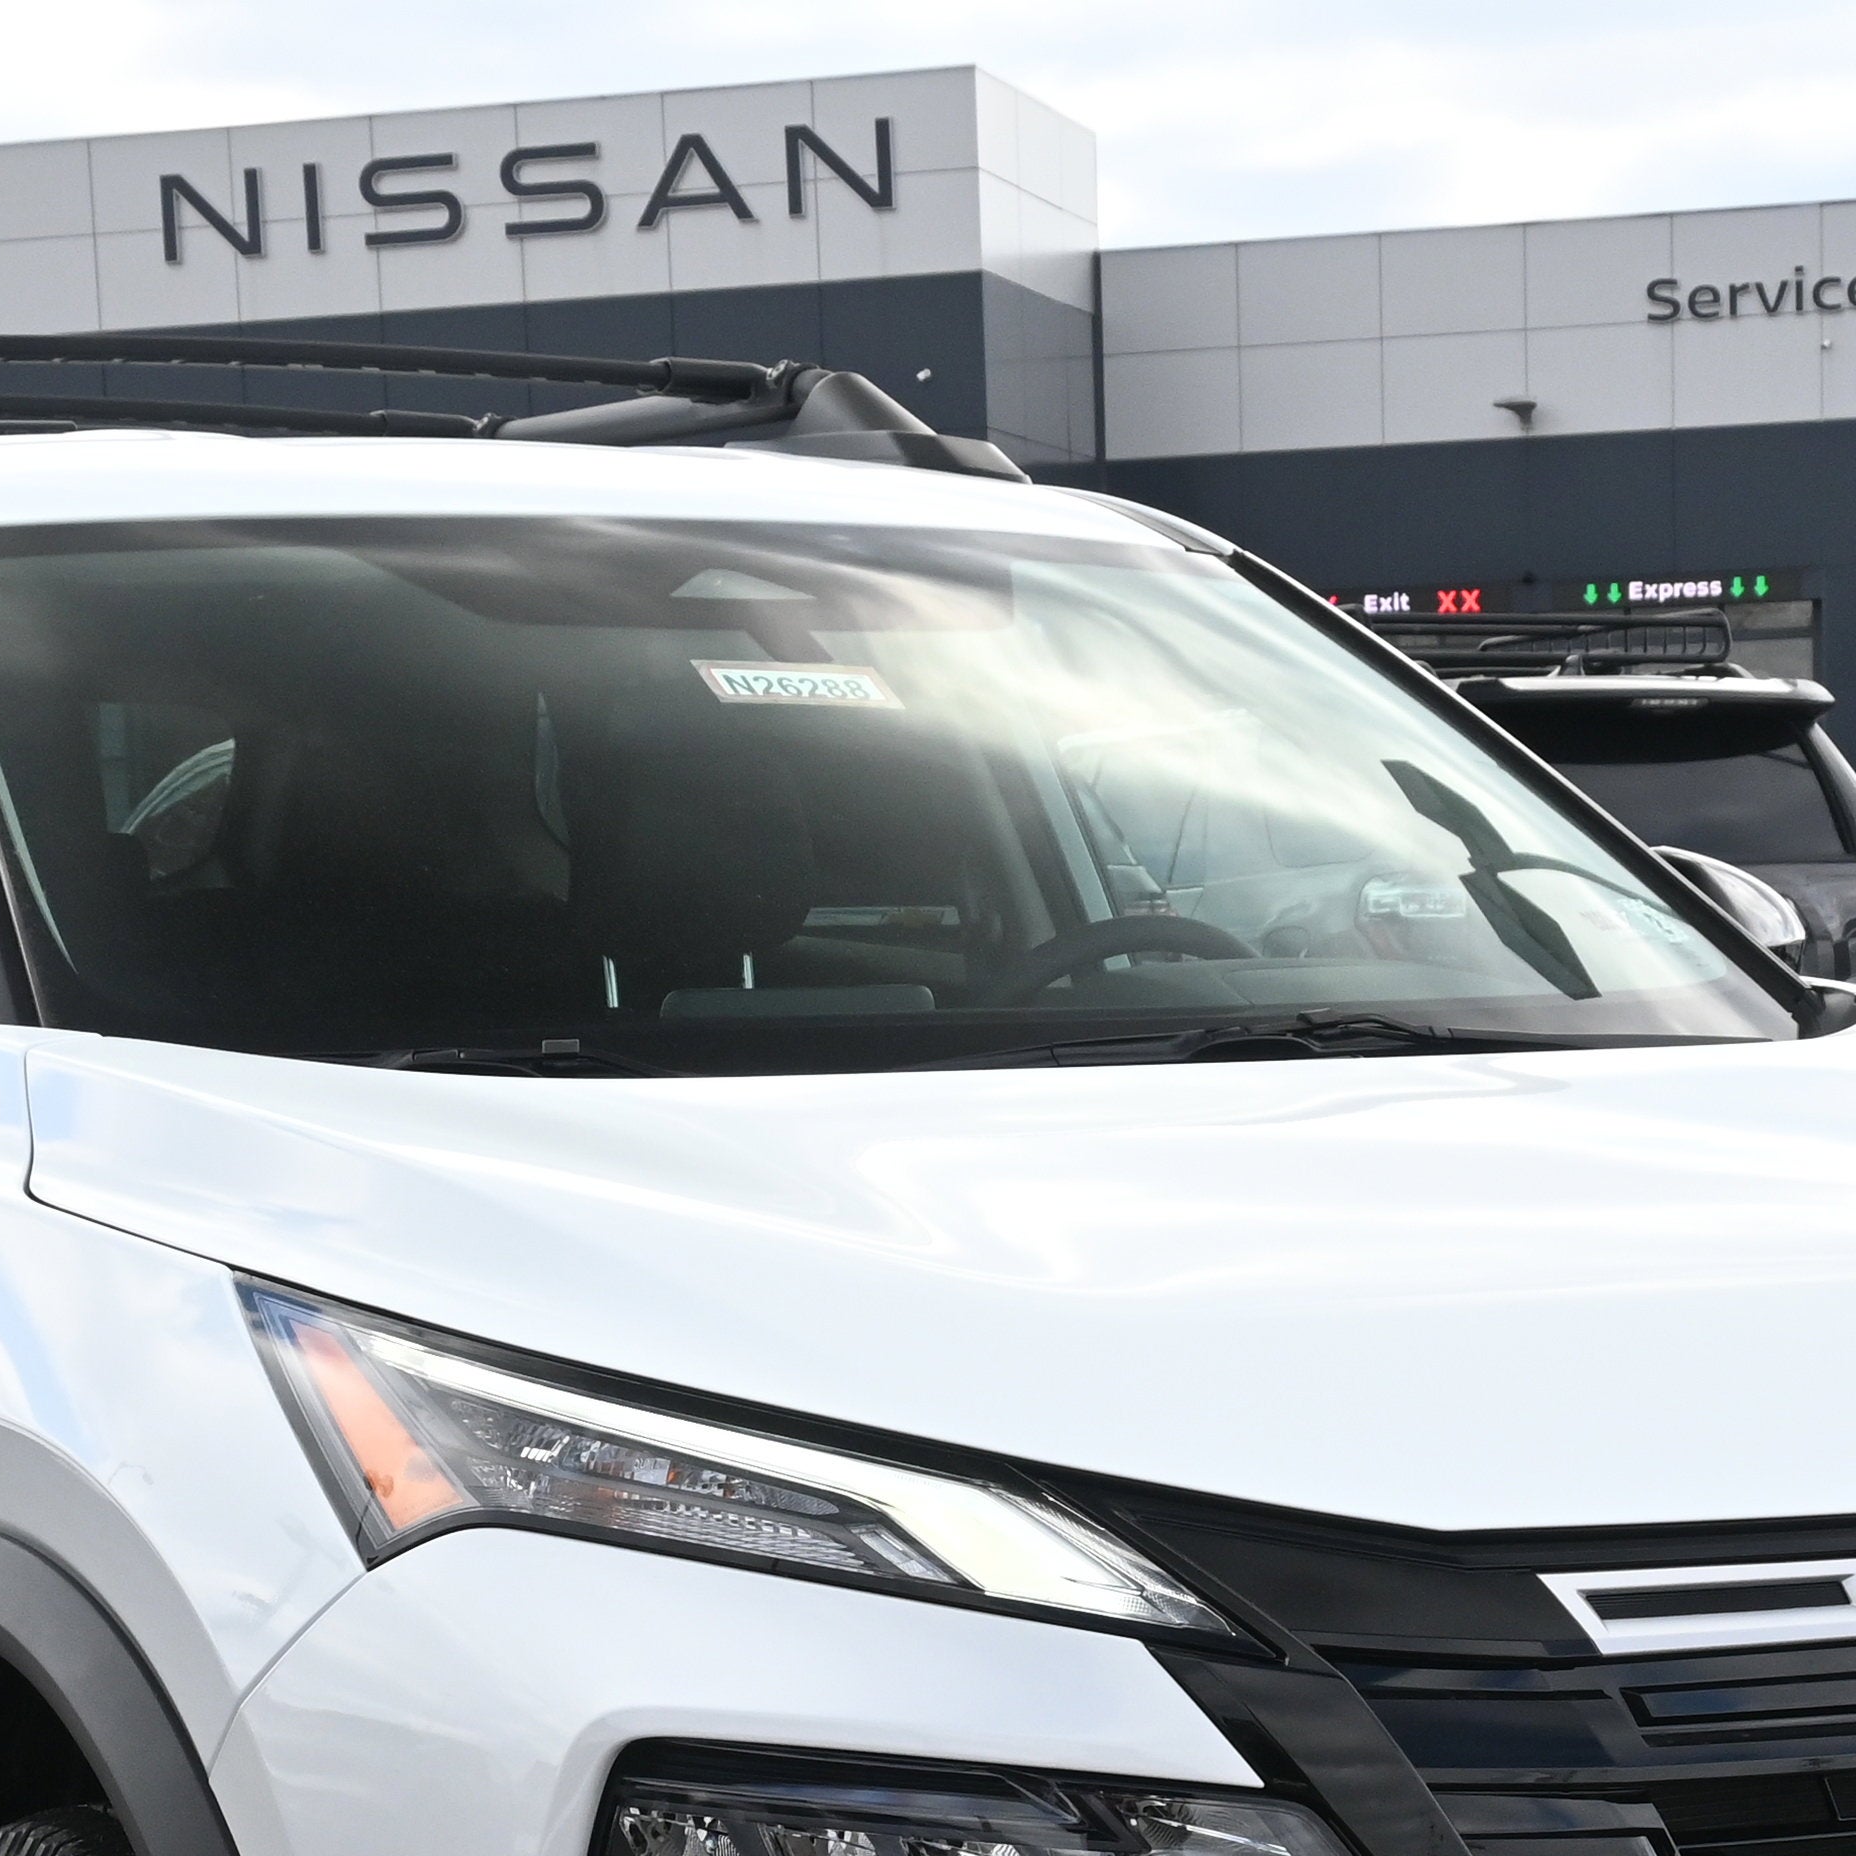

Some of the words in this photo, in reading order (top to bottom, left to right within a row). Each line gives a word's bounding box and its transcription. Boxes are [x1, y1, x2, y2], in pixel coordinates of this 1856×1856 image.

[158, 116, 895, 263] NISSAN
[1363, 591, 1411, 613] Exit
[1628, 580, 1722, 603] Express
[722, 673, 872, 699] N26288
